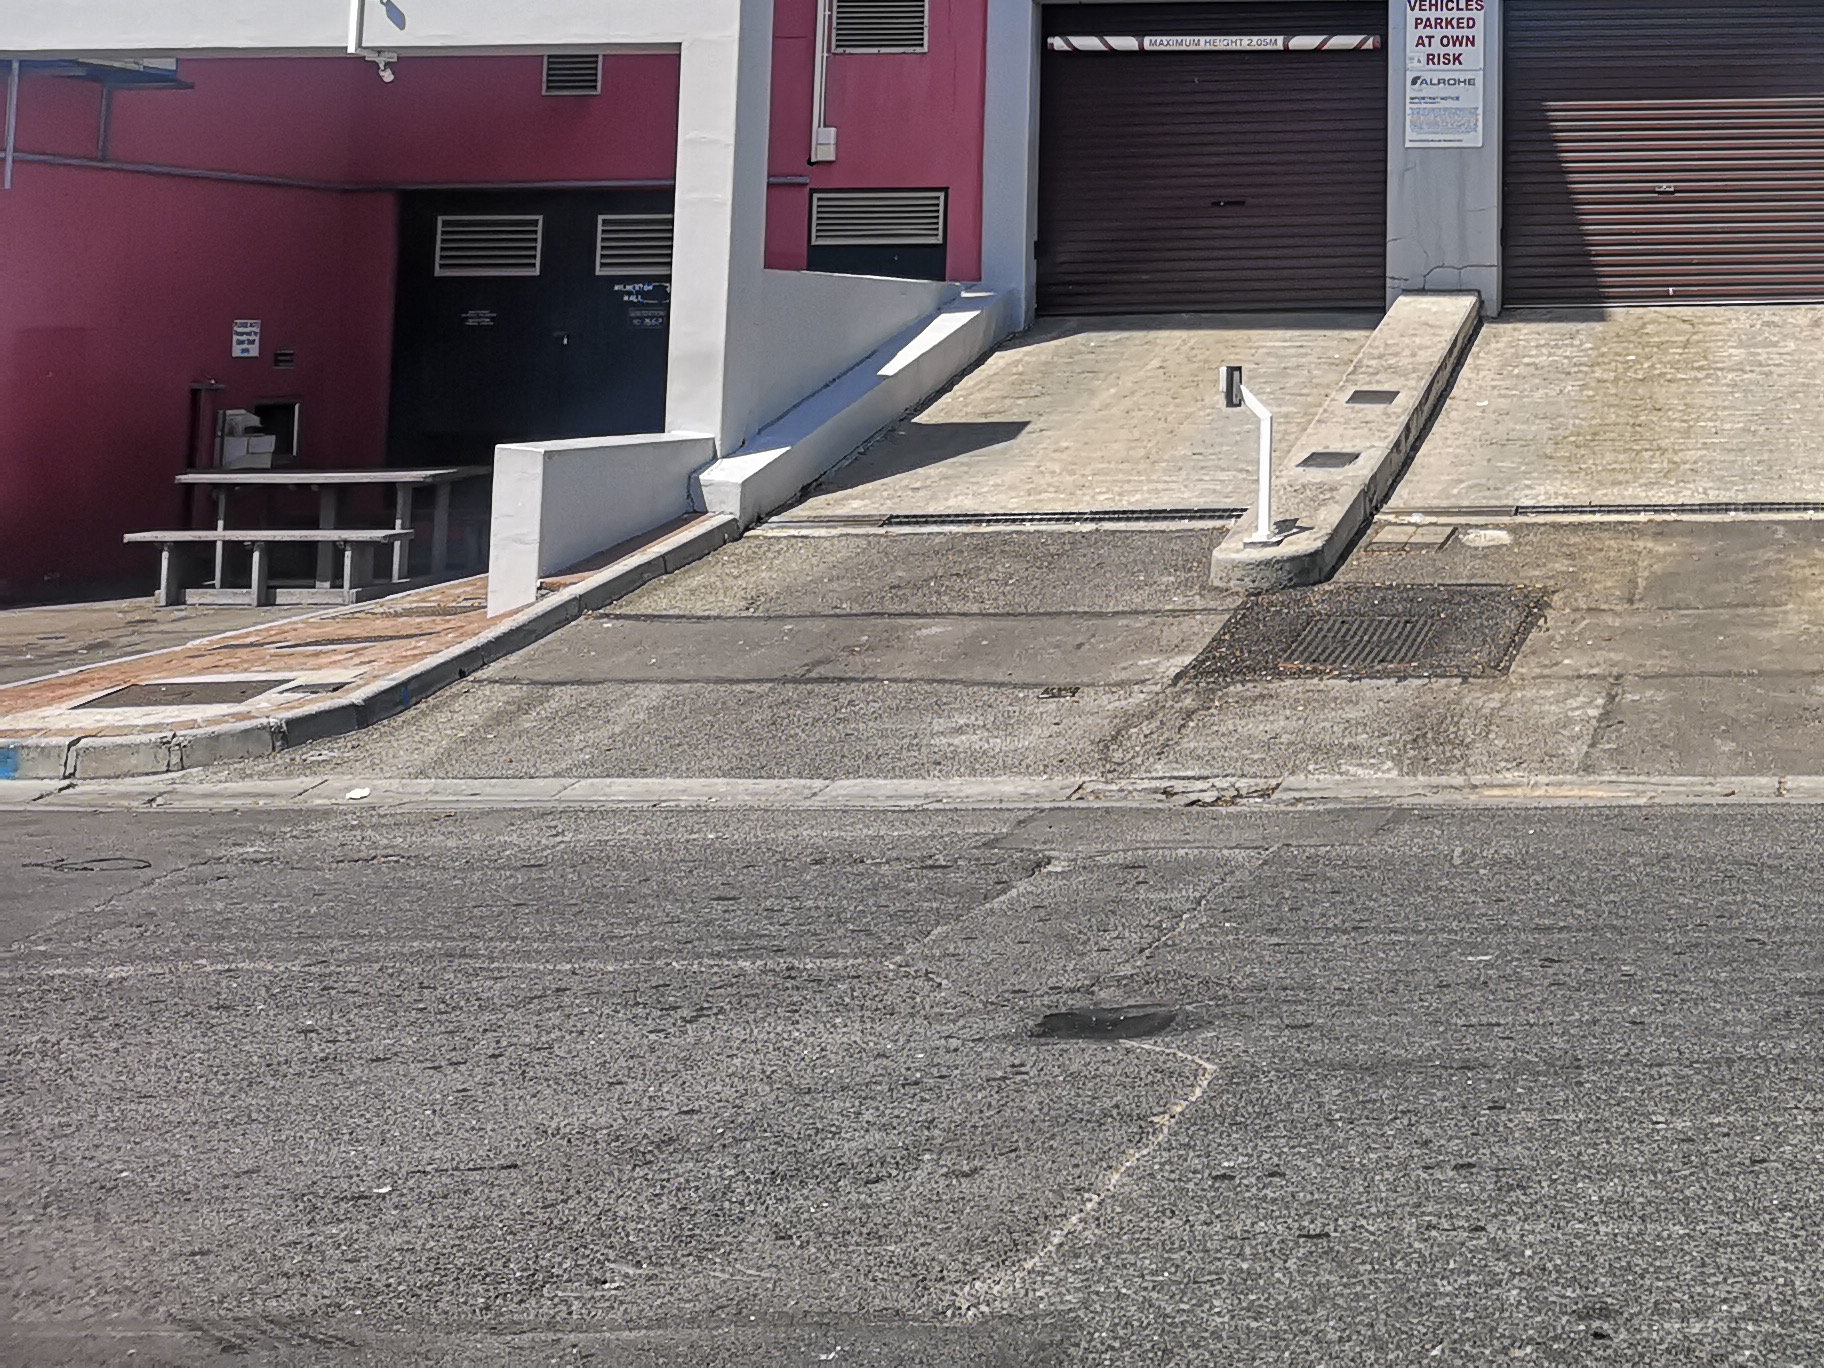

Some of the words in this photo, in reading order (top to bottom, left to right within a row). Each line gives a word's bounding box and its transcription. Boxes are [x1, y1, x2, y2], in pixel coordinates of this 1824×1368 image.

[1414, 17, 1476, 30] PARKED
[1149, 38, 1201, 47] MAXIMUM
[1204, 38, 1244, 47] HEIGHT
[1247, 38, 1278, 47] 2.05M
[1415, 35, 1435, 48] AT
[1440, 35, 1475, 48] OWN
[1426, 53, 1463, 66] RISK
